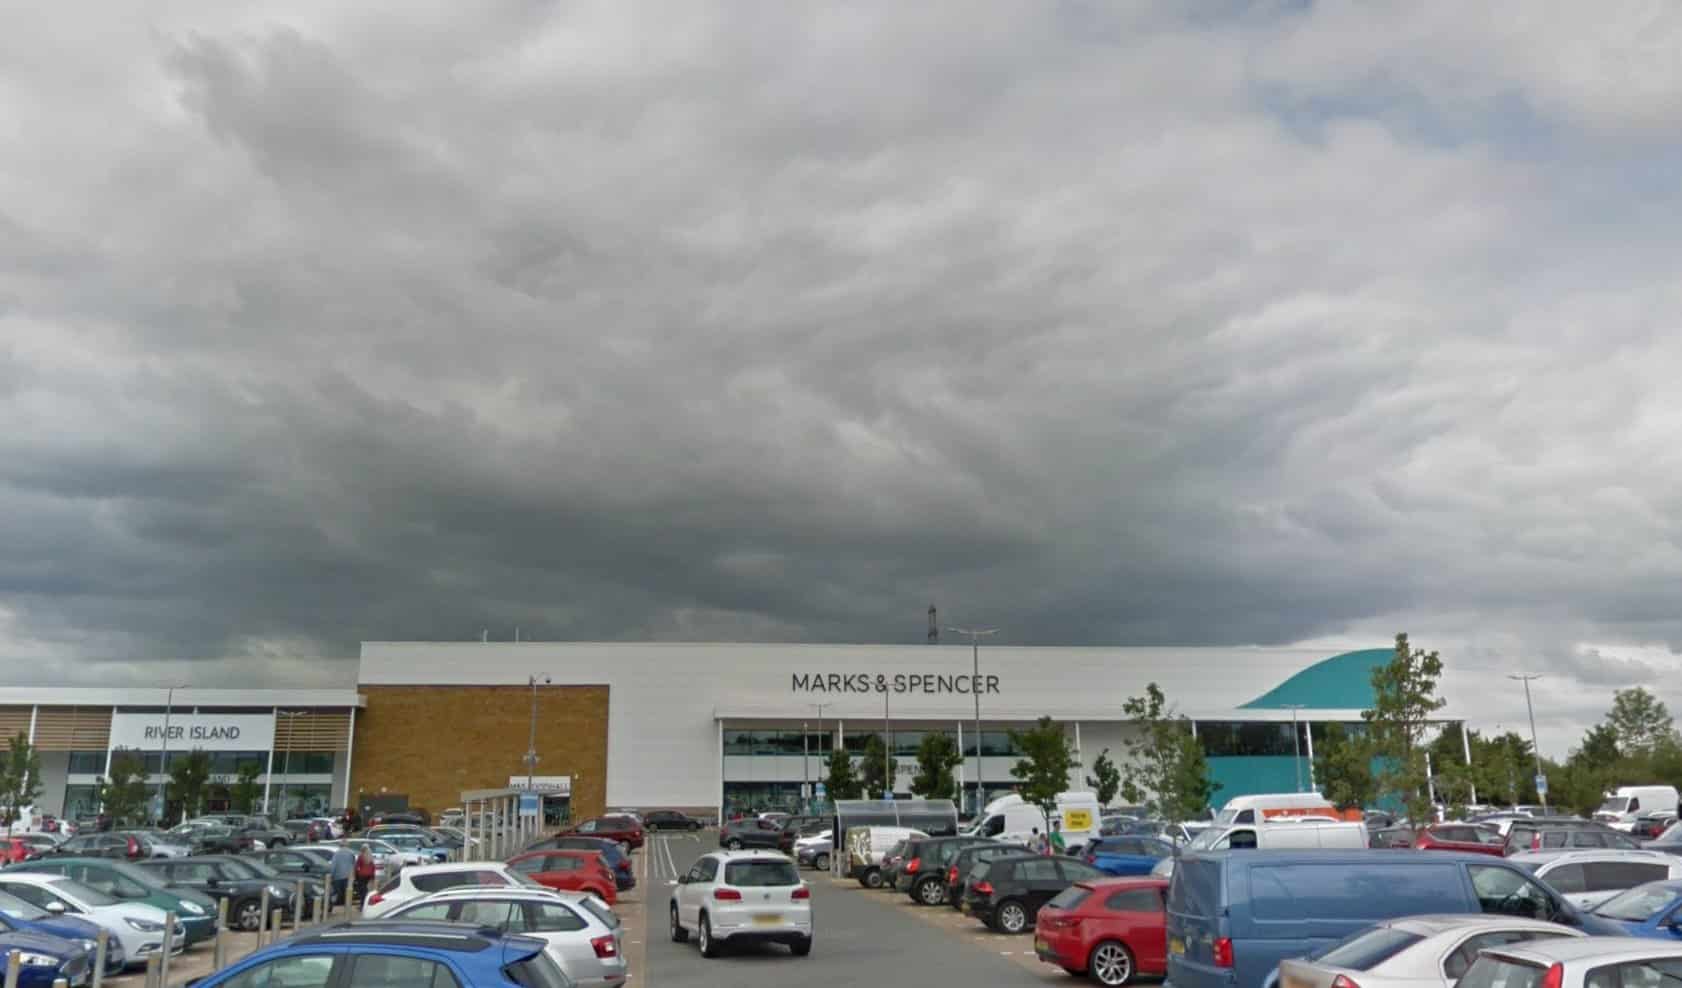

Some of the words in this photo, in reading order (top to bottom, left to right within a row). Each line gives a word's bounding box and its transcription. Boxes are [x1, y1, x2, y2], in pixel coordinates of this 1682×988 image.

[792, 673, 870, 693] MARKS
[875, 674, 888, 693] &
[894, 673, 1000, 694] SPENCER
[144, 726, 184, 740] RIVER
[189, 726, 241, 740] ISLAND
